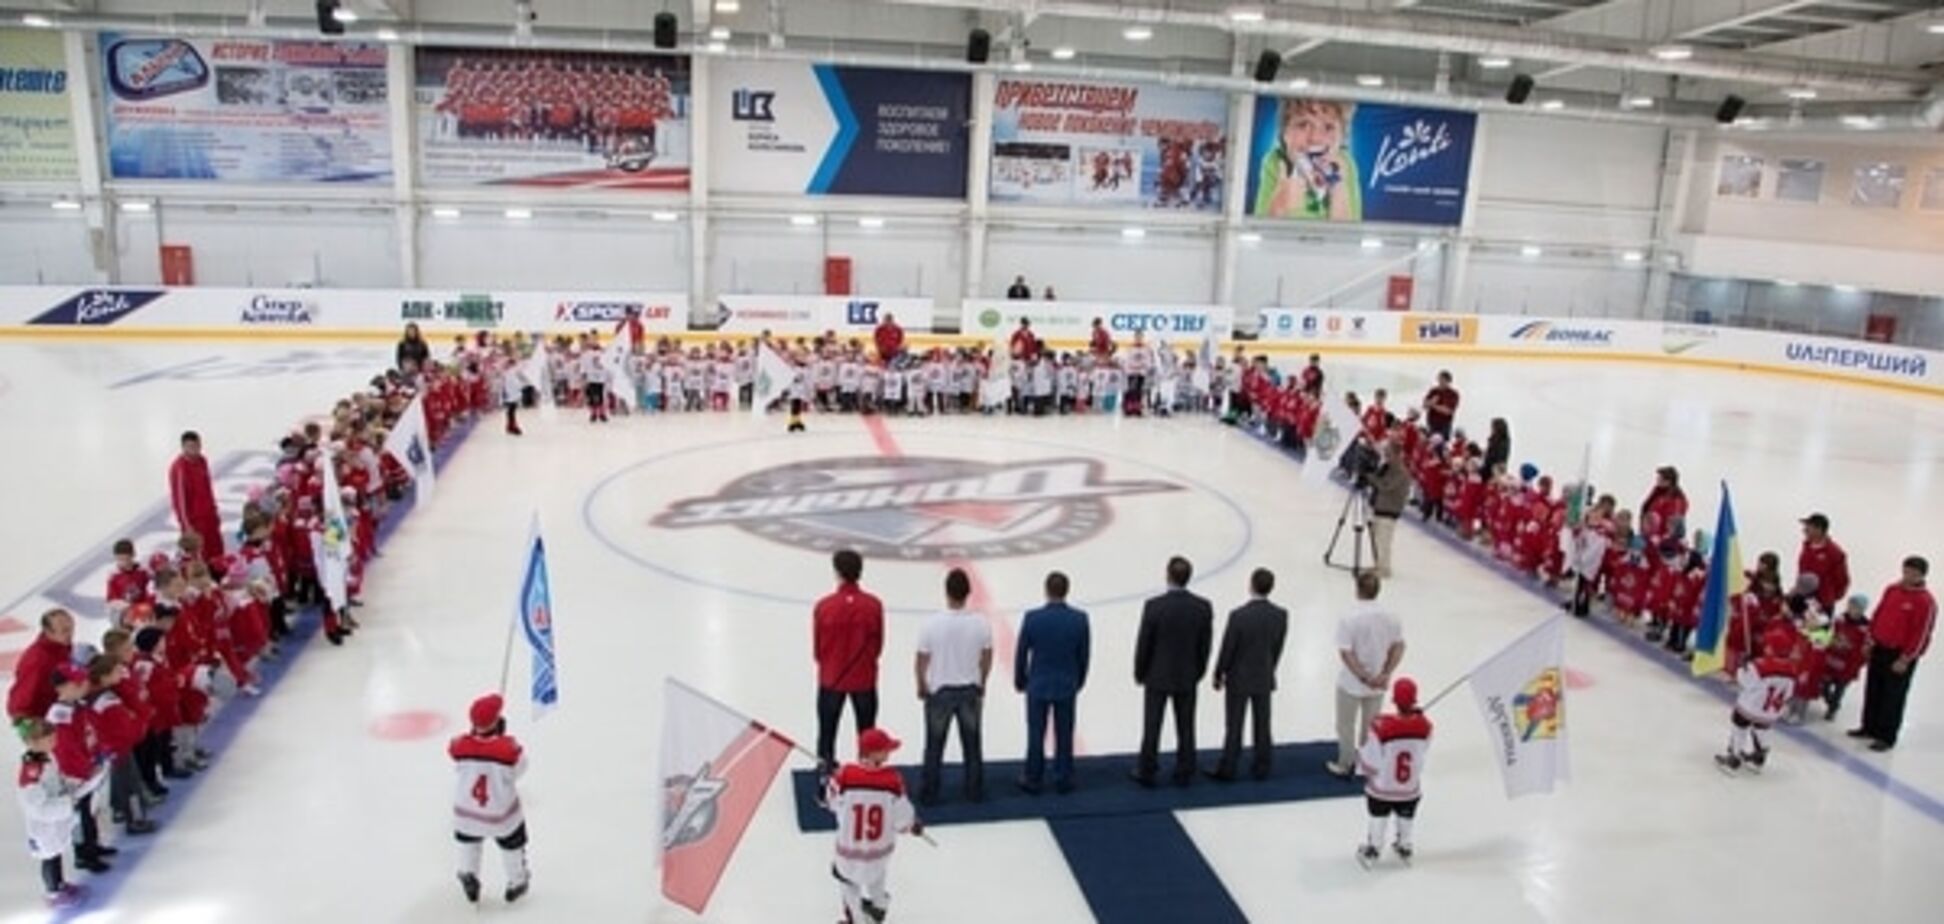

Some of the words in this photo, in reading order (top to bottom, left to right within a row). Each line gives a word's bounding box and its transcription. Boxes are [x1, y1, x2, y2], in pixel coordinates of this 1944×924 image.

[1396, 751, 1412, 784] 6
[471, 774, 489, 807] 4
[851, 803, 884, 841] 19
